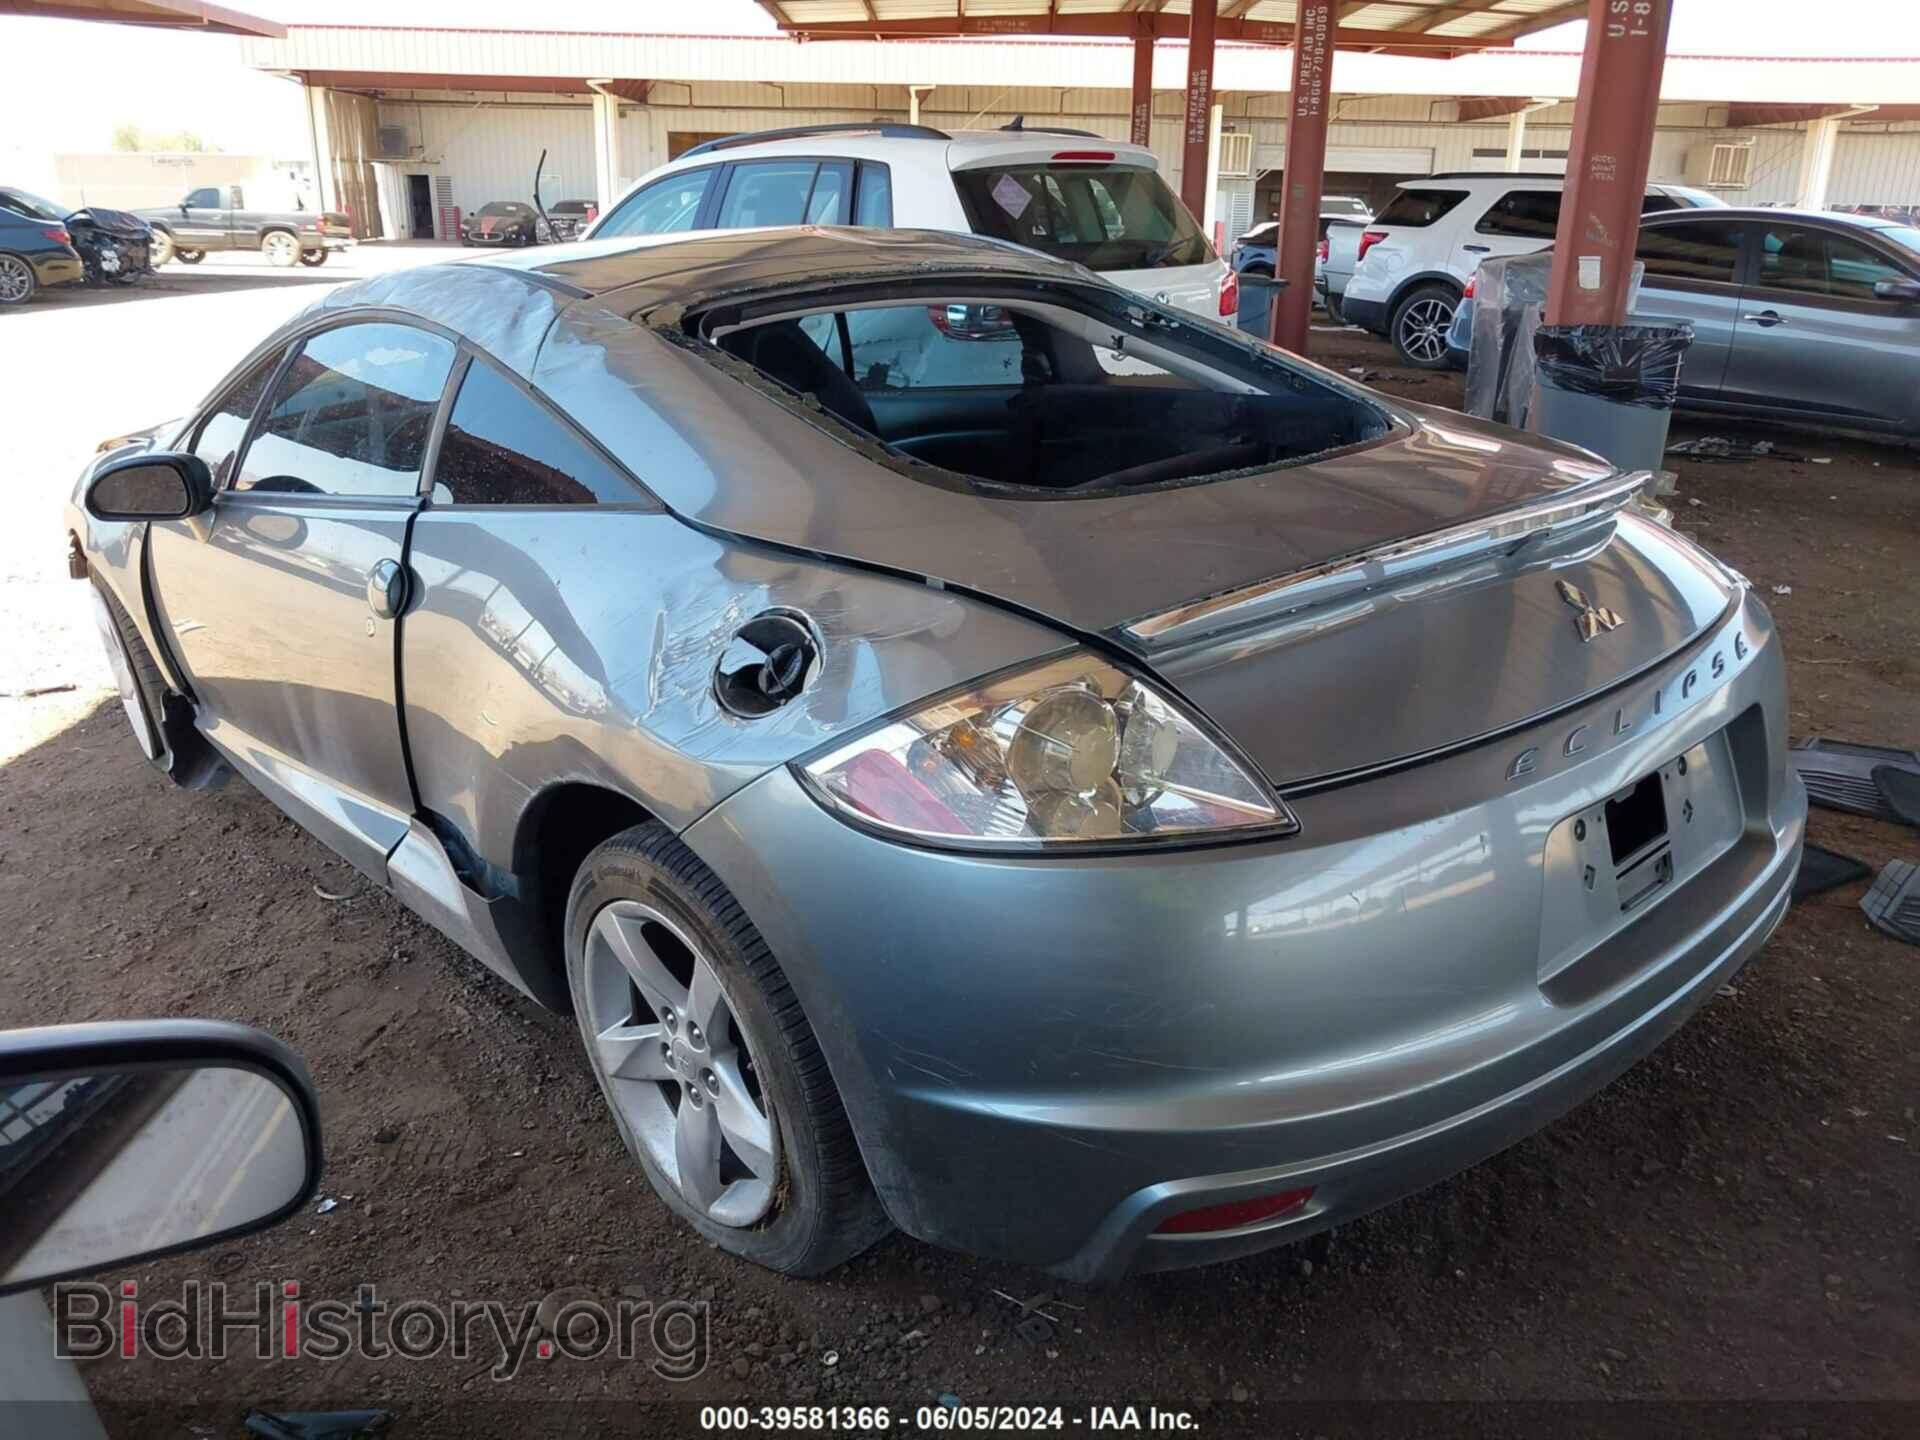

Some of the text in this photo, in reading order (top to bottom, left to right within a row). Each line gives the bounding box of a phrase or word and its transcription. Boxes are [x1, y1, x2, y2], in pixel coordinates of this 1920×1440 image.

[1300, 36, 1314, 86] PREFAB
[1296, 92, 1309, 117] U.S.
[1505, 631, 1749, 781] ECLIPSE
